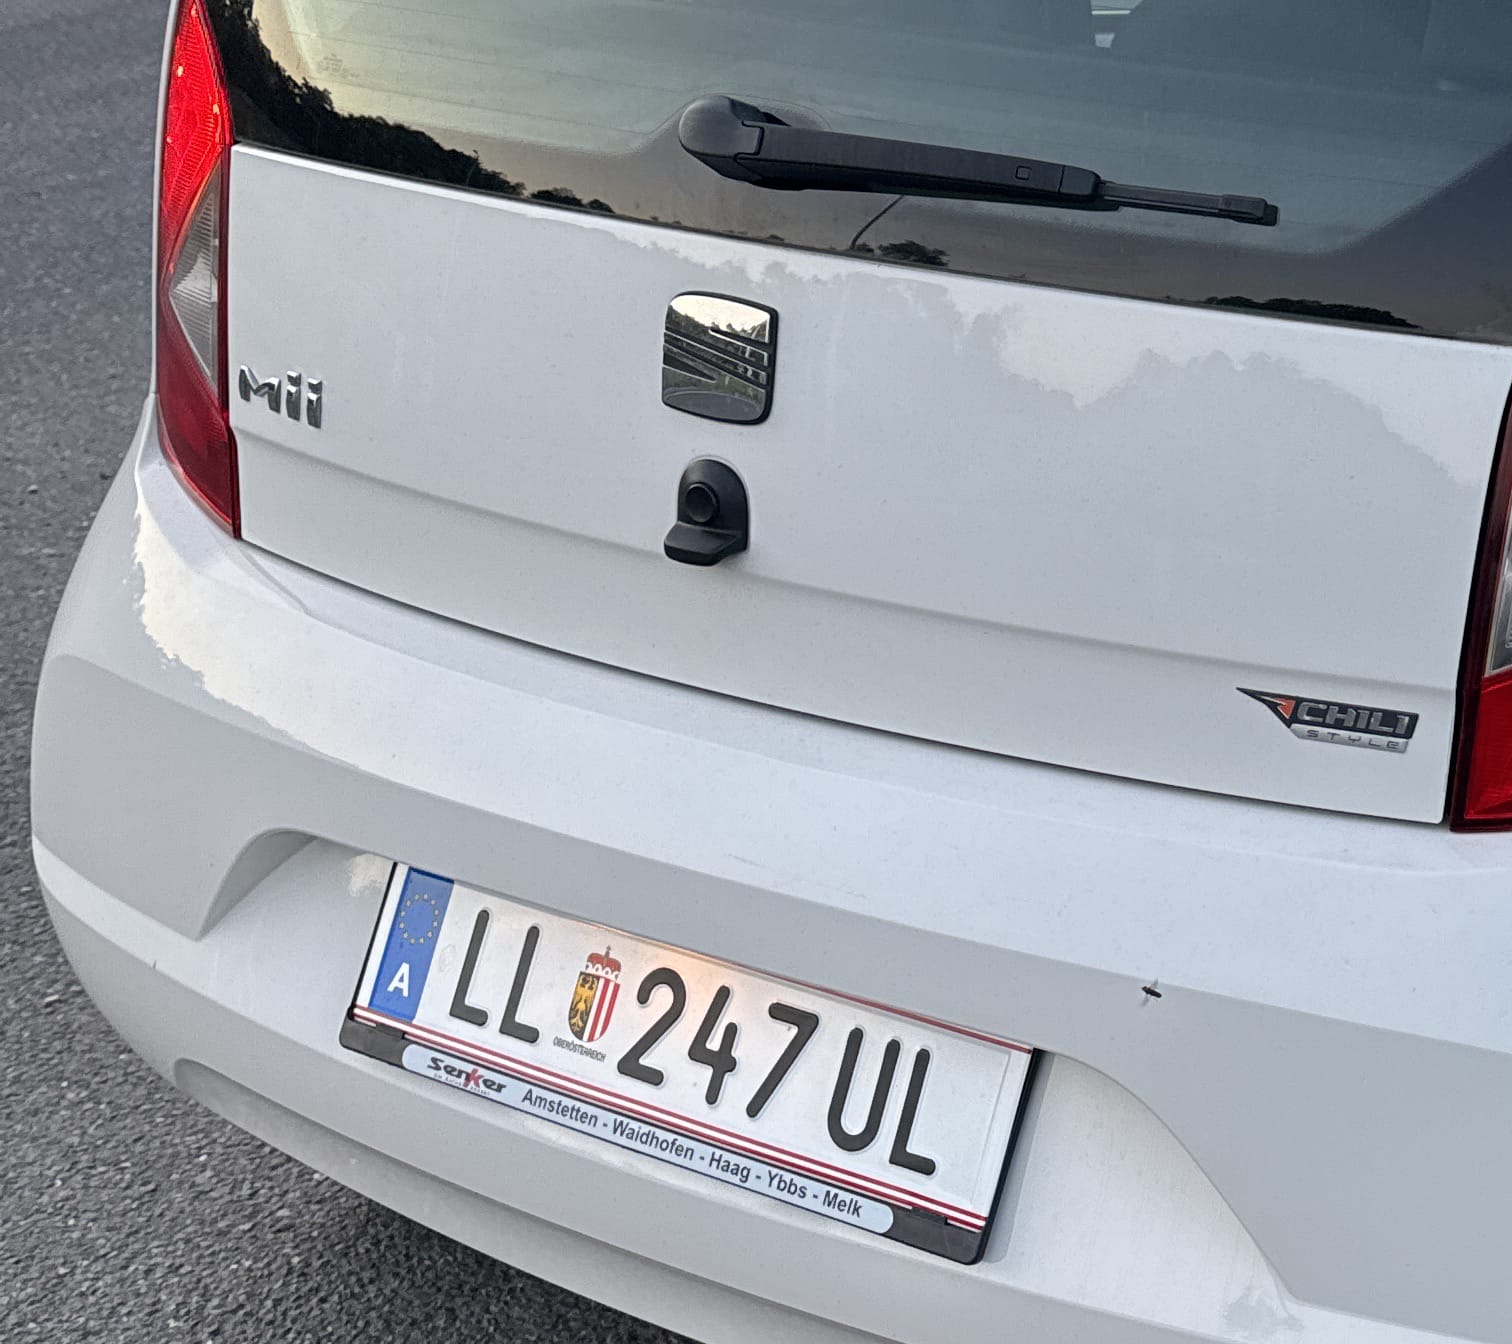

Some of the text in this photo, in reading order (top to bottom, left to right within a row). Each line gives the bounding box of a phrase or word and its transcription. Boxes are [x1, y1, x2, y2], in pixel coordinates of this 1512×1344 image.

[239, 364, 322, 430] Mii
[1297, 701, 1410, 735] CHILI
[1306, 729, 1400, 750] STYLE
[387, 961, 411, 998] A
[449, 909, 936, 1176] LL 247 UL
[521, 1088, 599, 1128] Amstetten
[613, 1118, 694, 1161] Waidhofen
[709, 1151, 750, 1183] Haag
[768, 1170, 807, 1199] Ybbs
[823, 1190, 862, 1218] Melk
